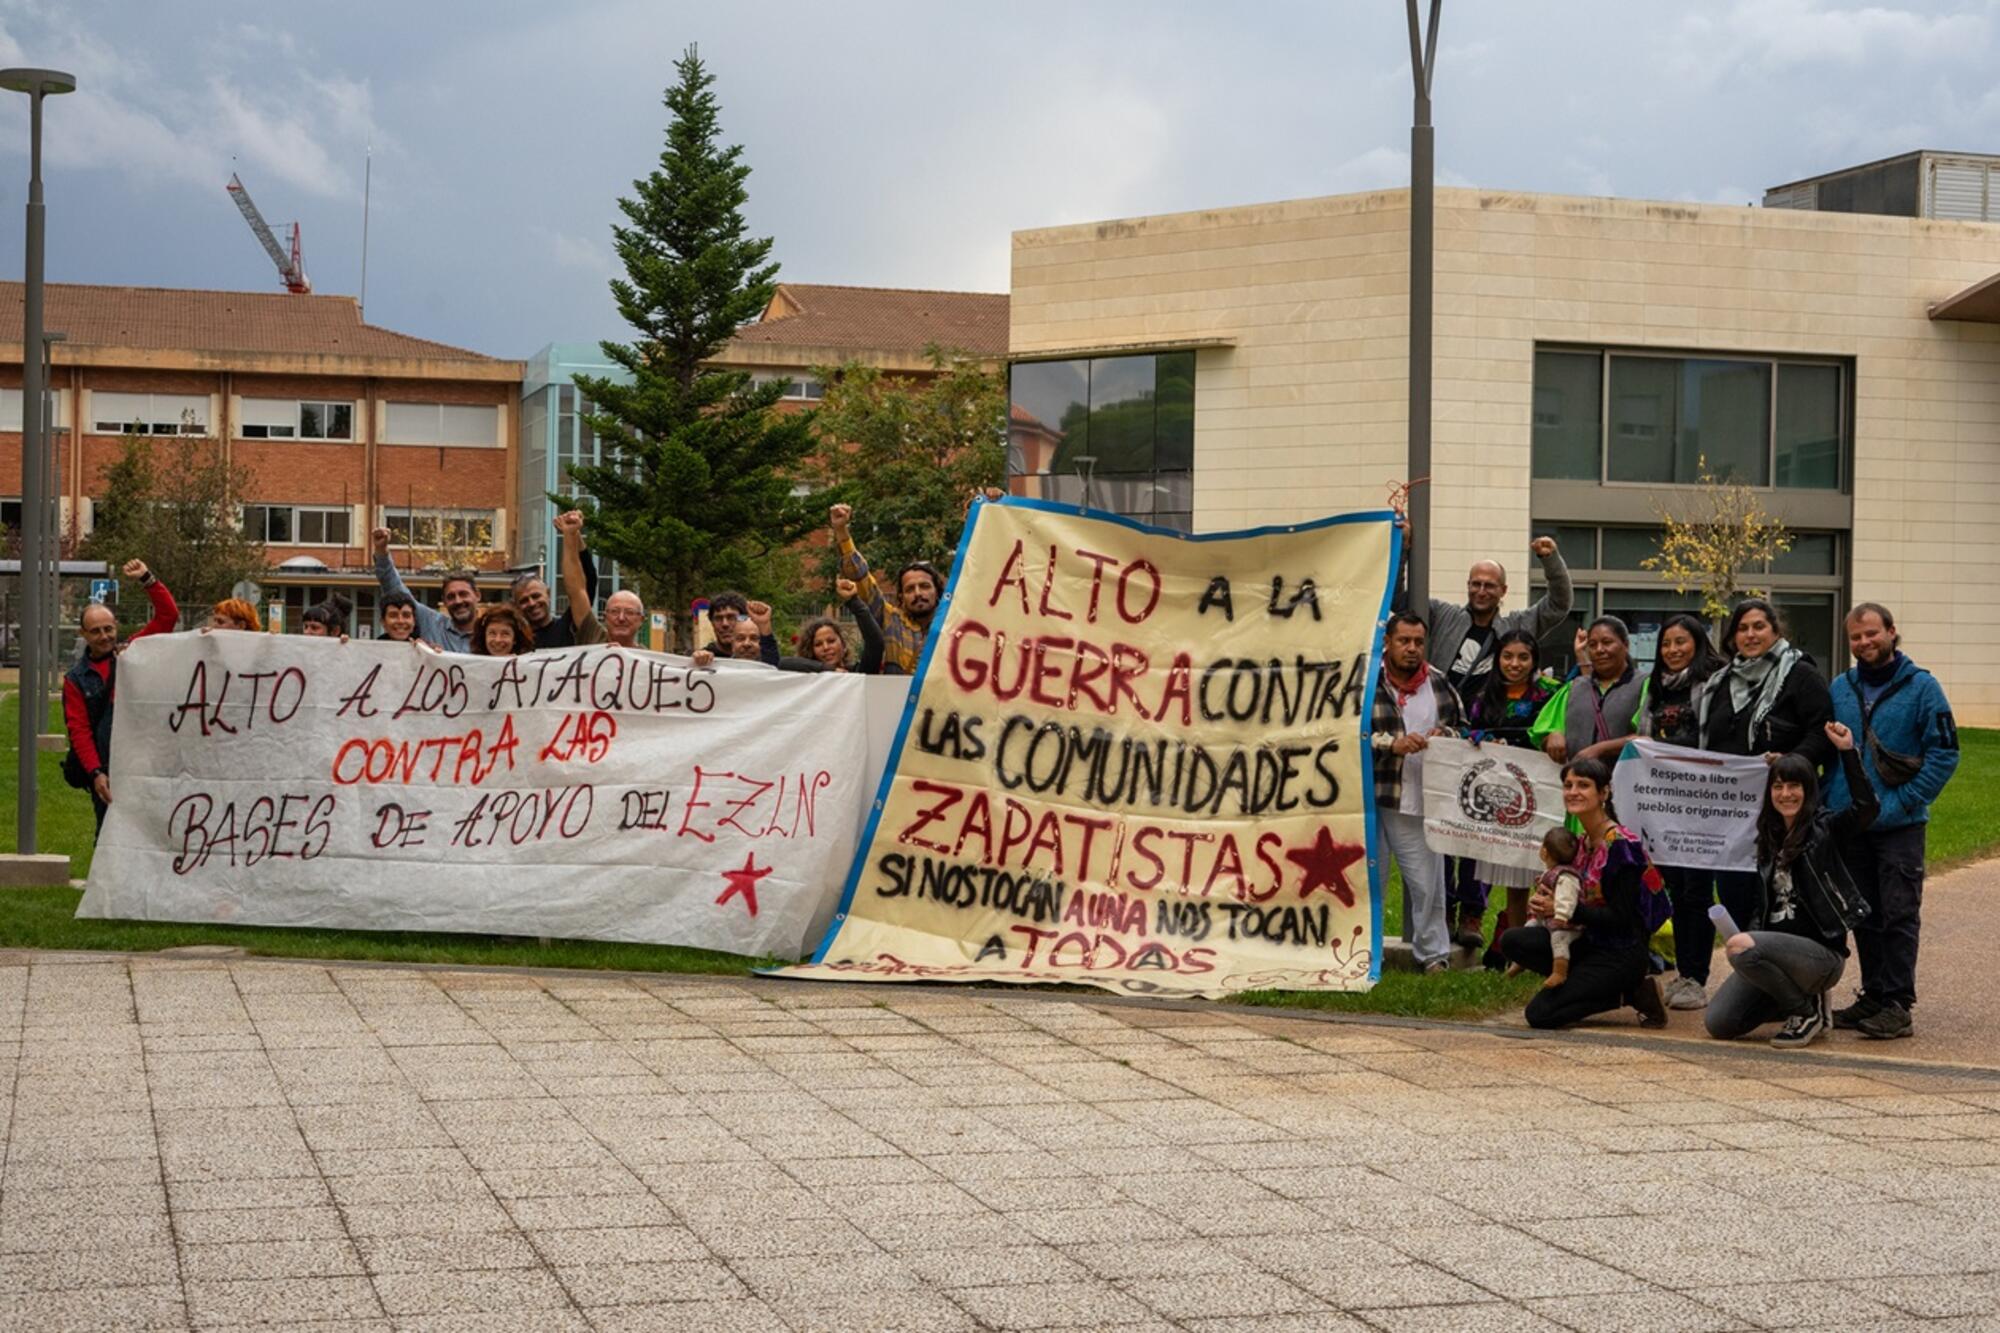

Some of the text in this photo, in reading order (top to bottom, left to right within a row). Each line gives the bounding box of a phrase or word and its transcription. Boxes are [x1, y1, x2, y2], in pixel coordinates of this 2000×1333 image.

[989, 539, 1322, 625] ALTO A LA
[169, 652, 716, 736] ALTO A LOS ATAQUES
[948, 620, 1192, 726] GUERRA
[331, 711, 617, 785] CONTRA LAS
[918, 708, 1341, 815] LAS COMUNIDADES
[1650, 767, 1738, 785] Respeto a libre
[168, 765, 832, 875] BASES DE APOYO DEL EZLN
[1685, 805, 1750, 820] originarios
[1721, 791, 1738, 802] de
[1740, 791, 1757, 803] los
[899, 779, 1283, 902] ZAPATISTAS
[876, 852, 916, 898] SI
[1154, 899, 1213, 942] NOS
[1218, 902, 1330, 948] TOCAN
[973, 924, 1218, 975] A TODAS
